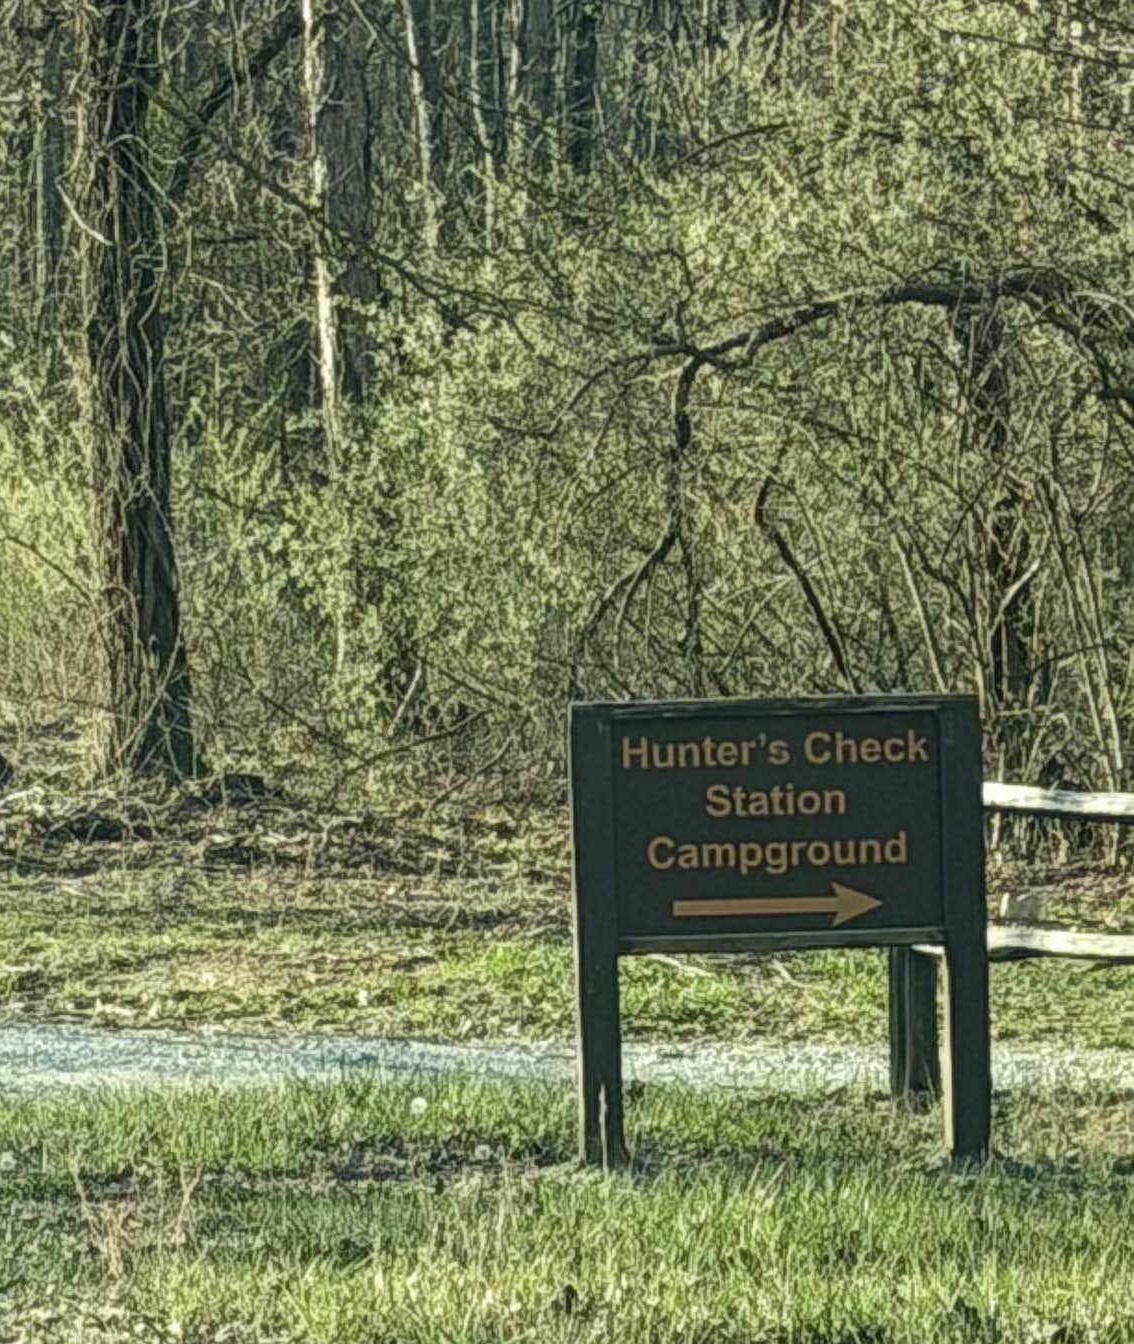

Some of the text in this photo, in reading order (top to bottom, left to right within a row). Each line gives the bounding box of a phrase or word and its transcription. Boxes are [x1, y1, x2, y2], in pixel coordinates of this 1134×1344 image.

[622, 730, 930, 769] Hunter's Check
[705, 784, 847, 818] Station
[647, 831, 908, 875] Campground
